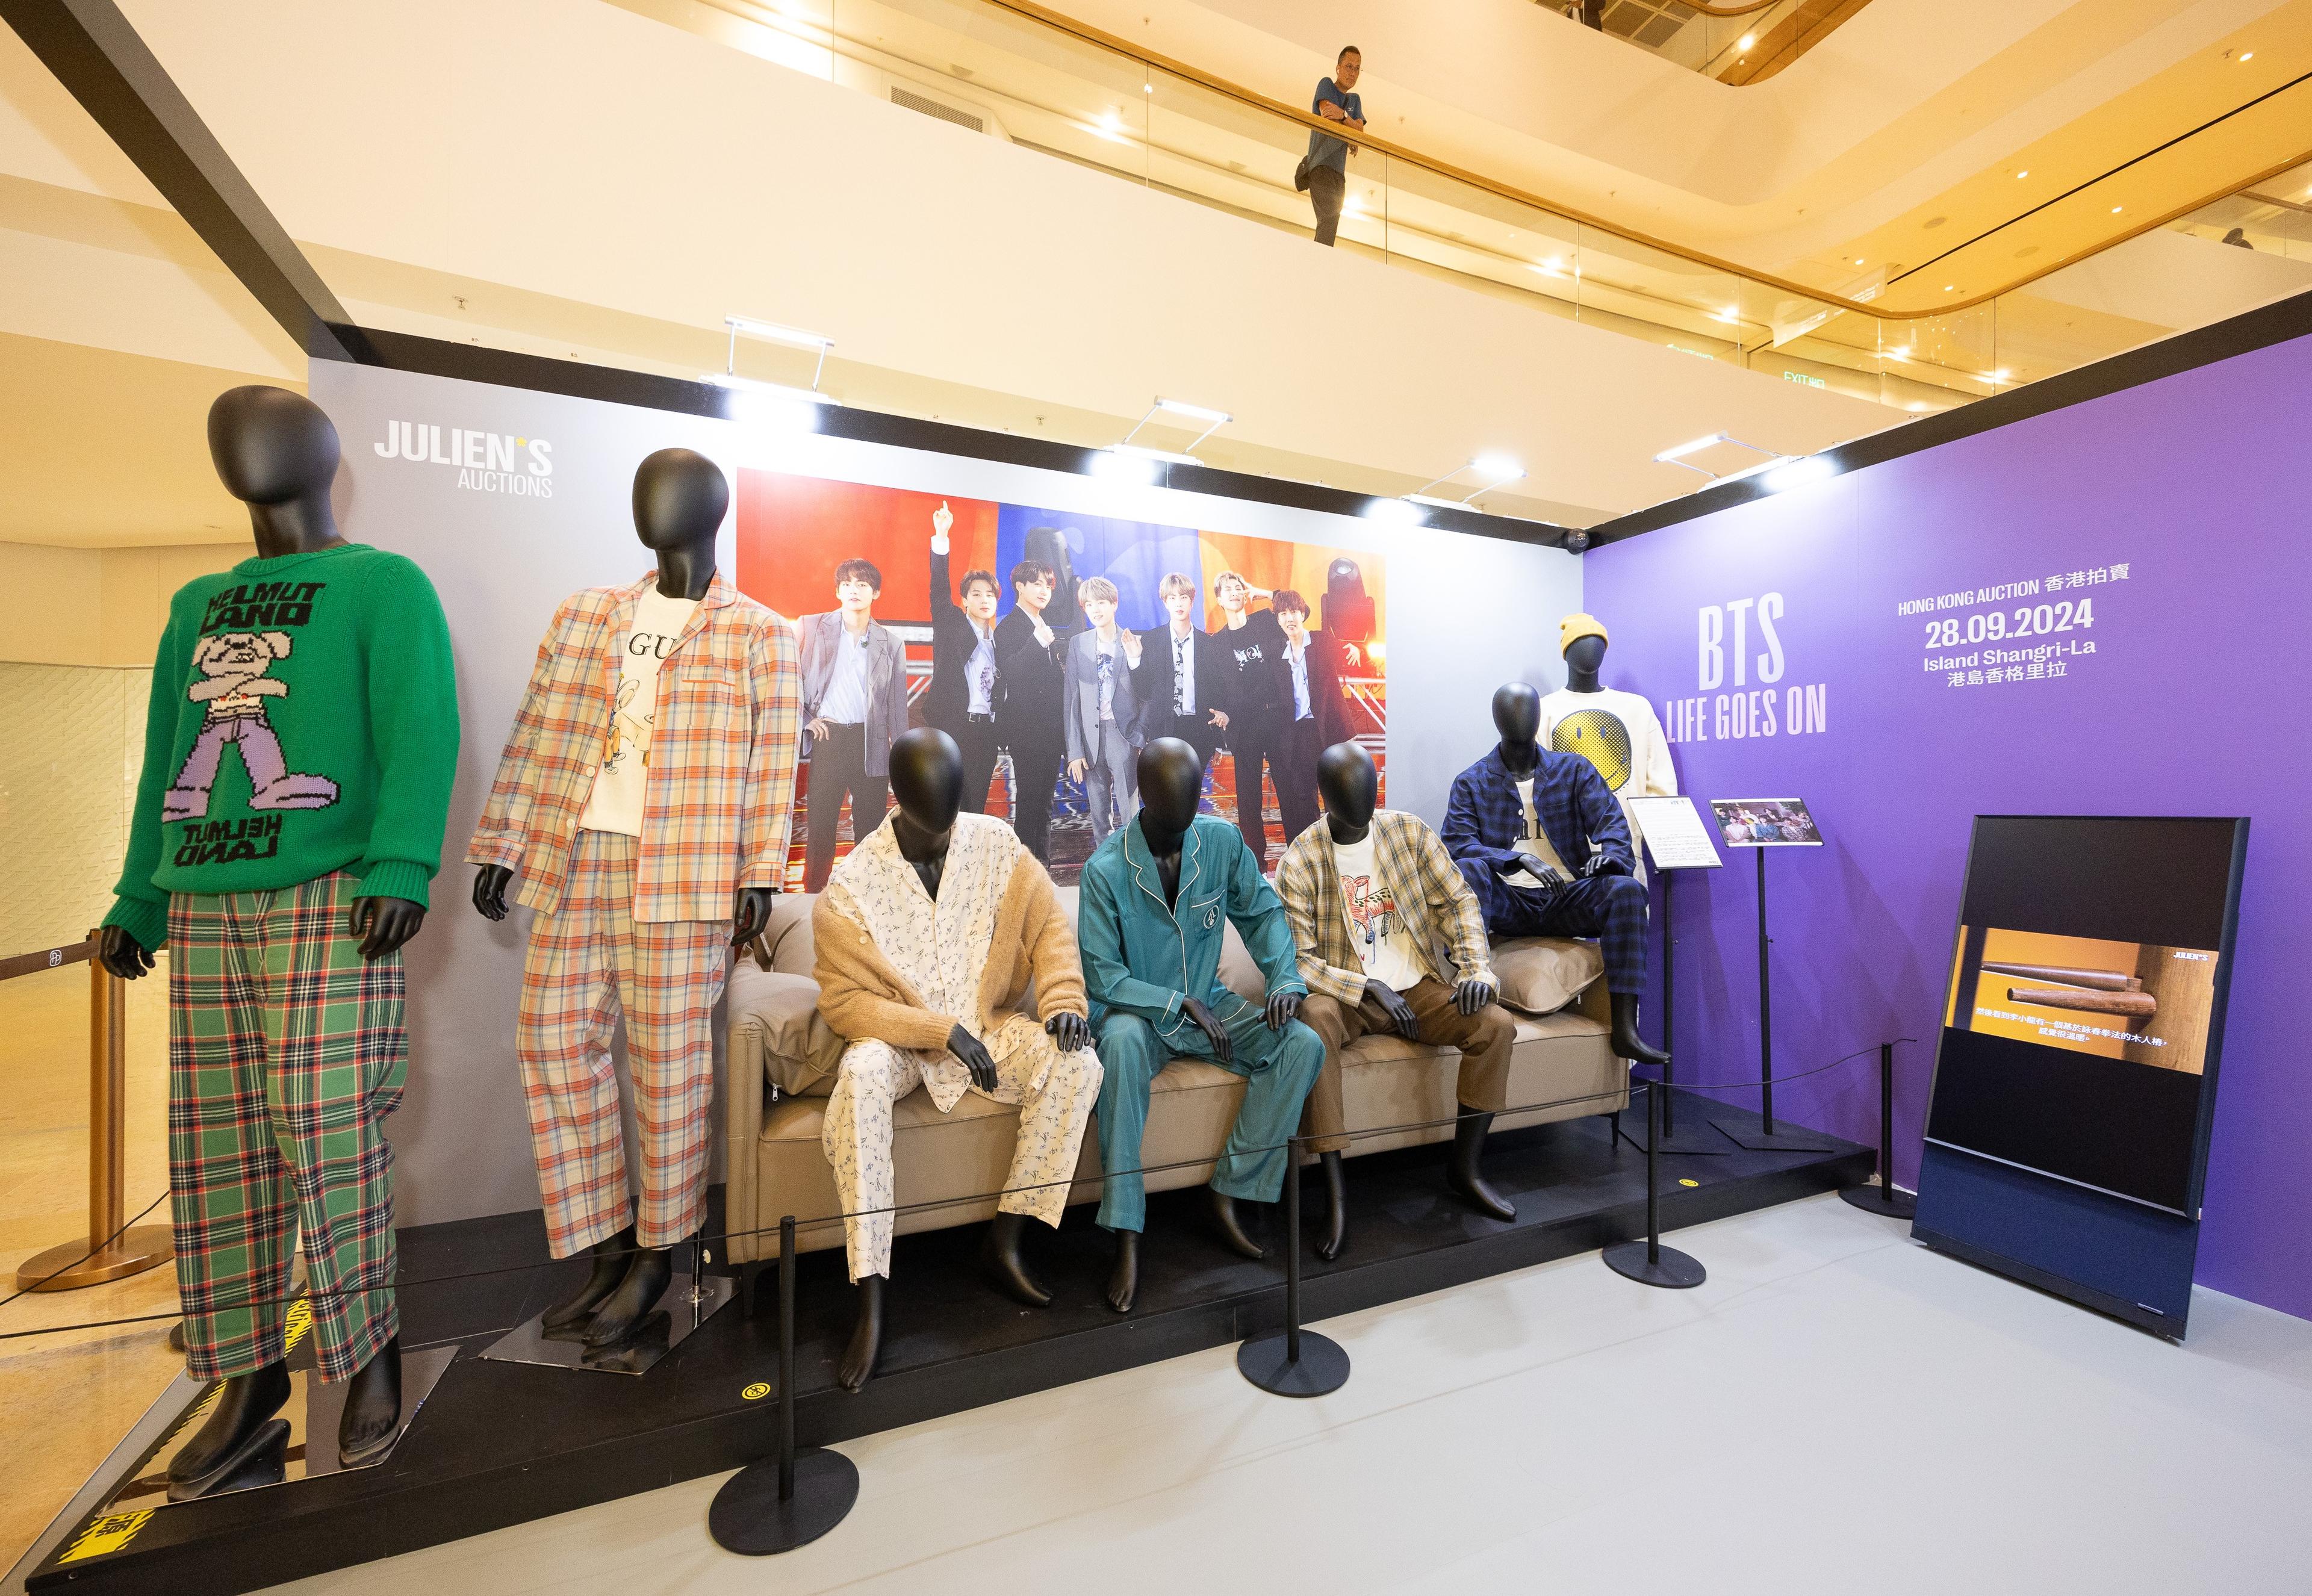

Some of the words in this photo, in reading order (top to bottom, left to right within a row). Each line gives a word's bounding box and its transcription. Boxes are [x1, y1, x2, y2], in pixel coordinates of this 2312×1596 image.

[1784, 371, 1808, 385] EXIT
[458, 468, 553, 498] AUCTIONS
[2045, 563, 2130, 592] 香港拍賣
[1898, 597, 1934, 616] HONG
[1937, 591, 1974, 610] KONG
[1976, 579, 2039, 603] AUCTION
[1925, 598, 2095, 649] 28.09.2024
[1699, 592, 1785, 691] BTS
[1924, 652, 1978, 672] Island
[1983, 639, 2096, 663] Shangri-La
[1947, 660, 2068, 688] 港島香格里拉
[1667, 697, 1708, 743] LIFE
[1716, 689, 1777, 740] GOES
[1787, 683, 1826, 735] ON
